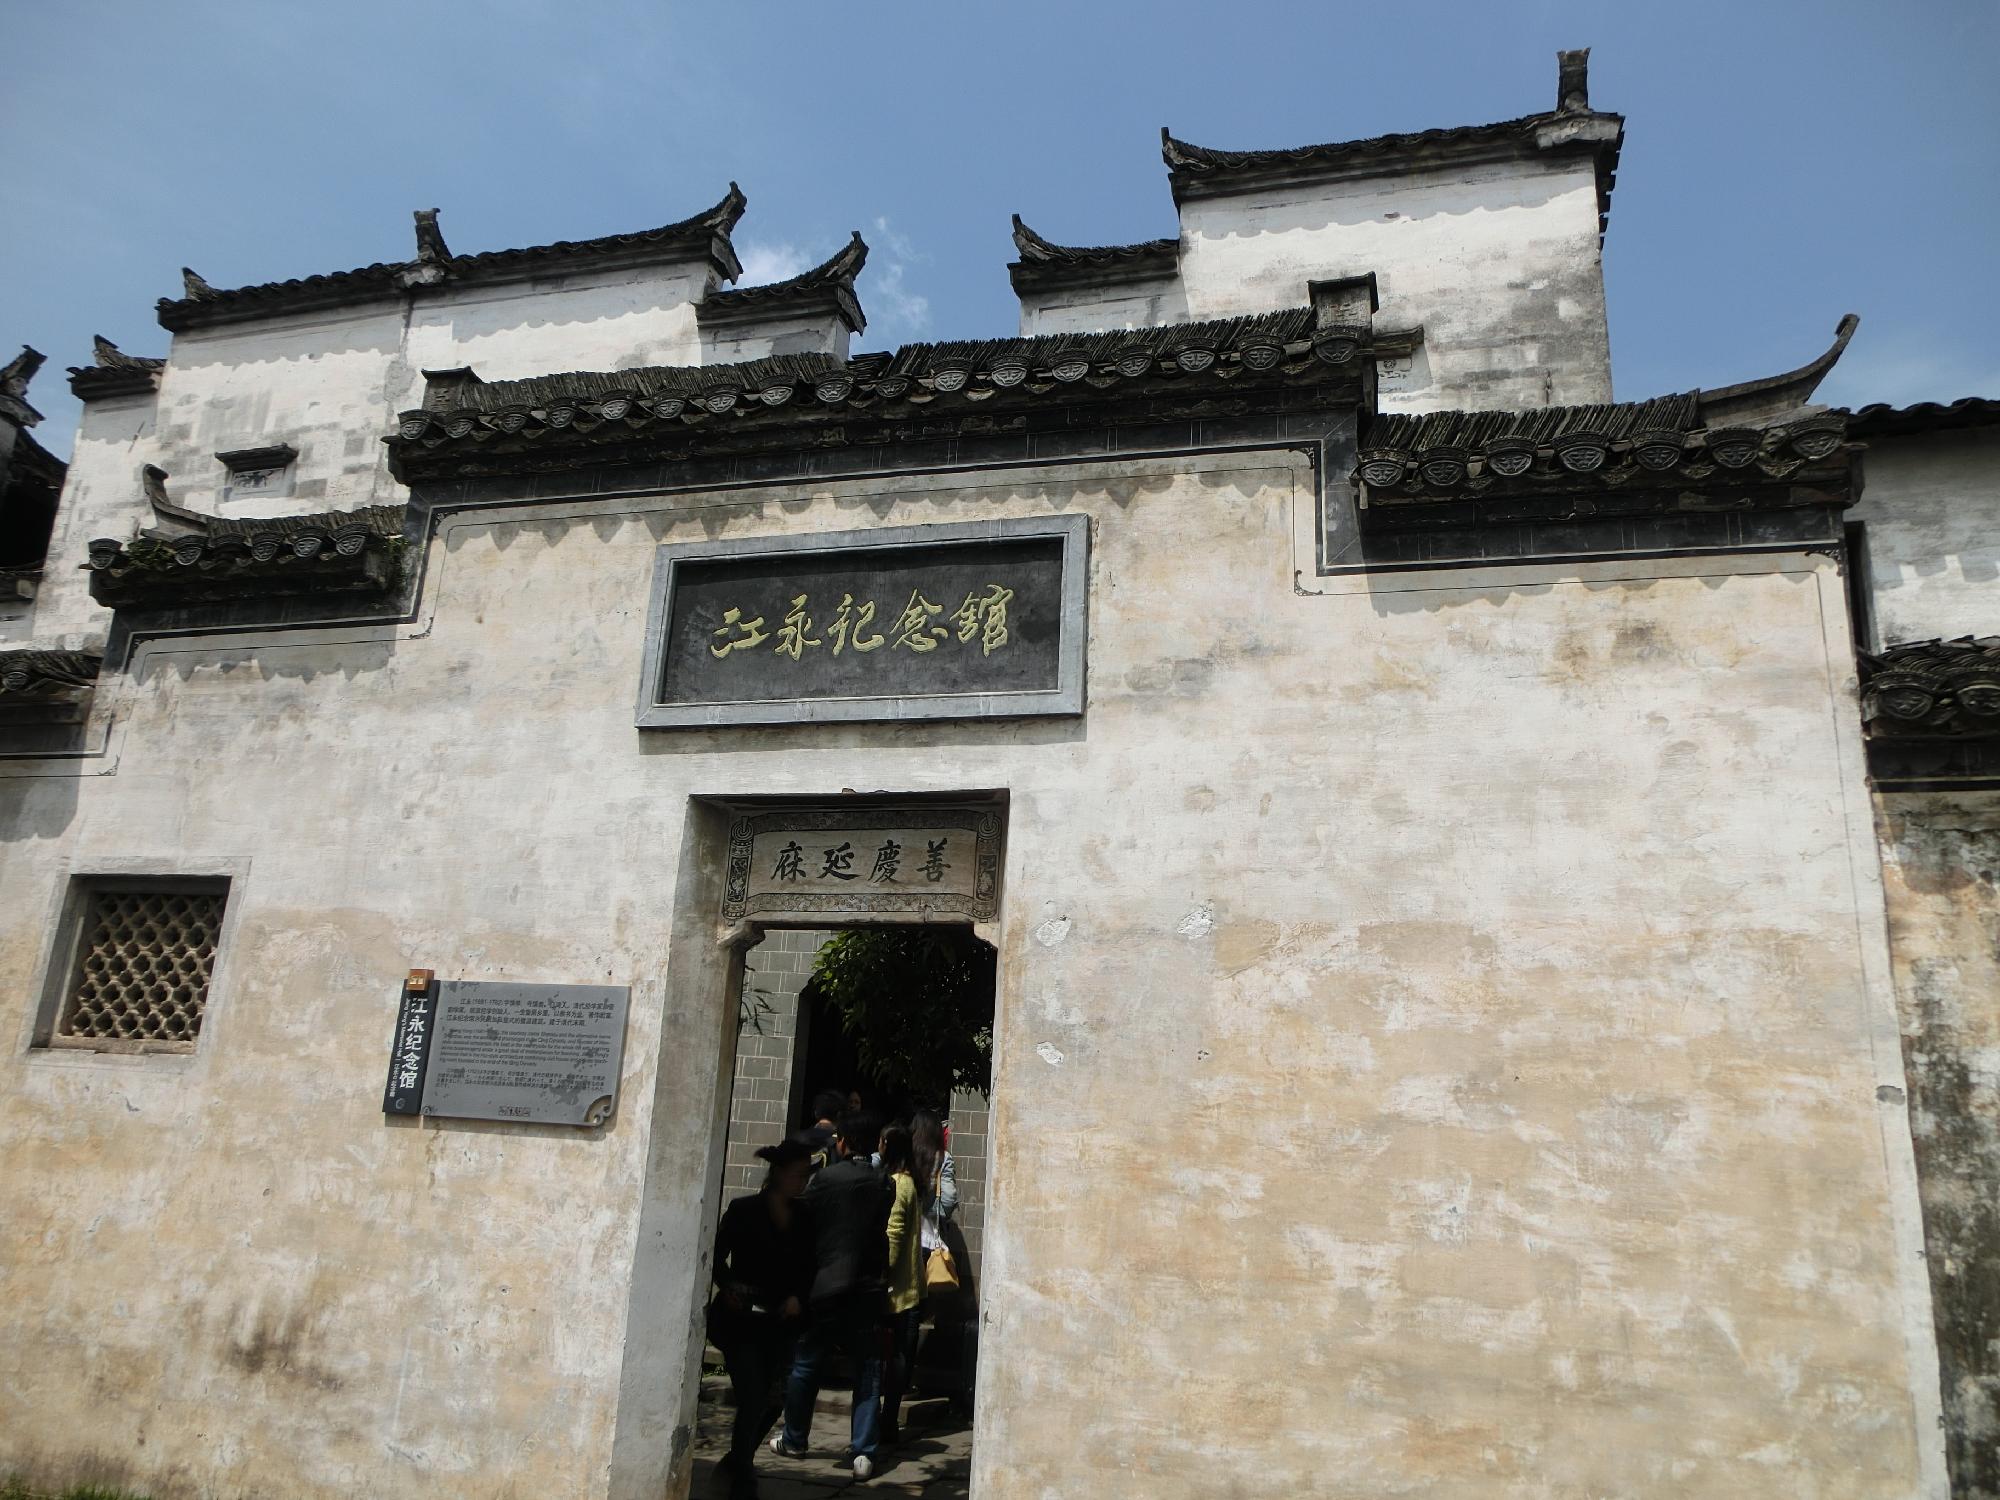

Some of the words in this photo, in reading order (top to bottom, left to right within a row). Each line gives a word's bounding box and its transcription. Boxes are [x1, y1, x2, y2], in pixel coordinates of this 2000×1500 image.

[399, 997, 429, 1089] 江永纪念馆
